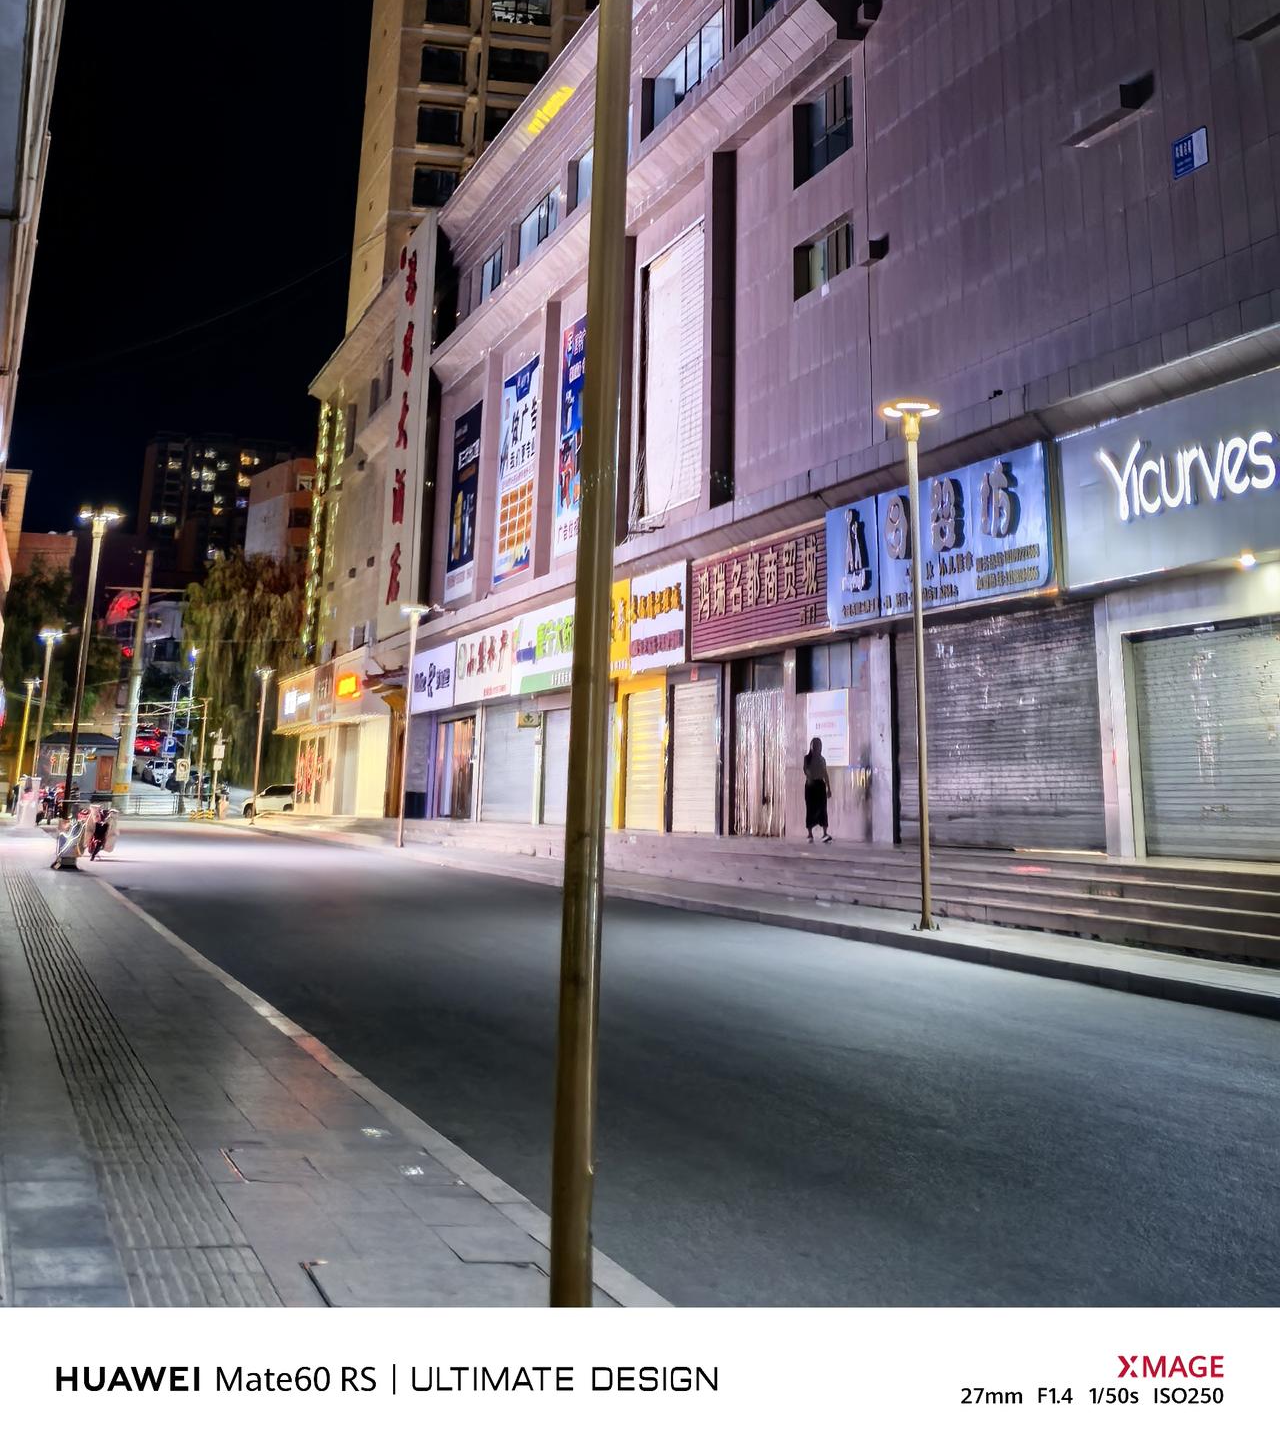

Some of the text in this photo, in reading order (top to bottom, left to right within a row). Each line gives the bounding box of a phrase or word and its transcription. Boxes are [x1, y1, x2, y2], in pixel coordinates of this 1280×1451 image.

[1097, 431, 1276, 521] Yicurves
[697, 533, 819, 623] 鸿瑞名都商贸城
[165, 737, 175, 752] P
